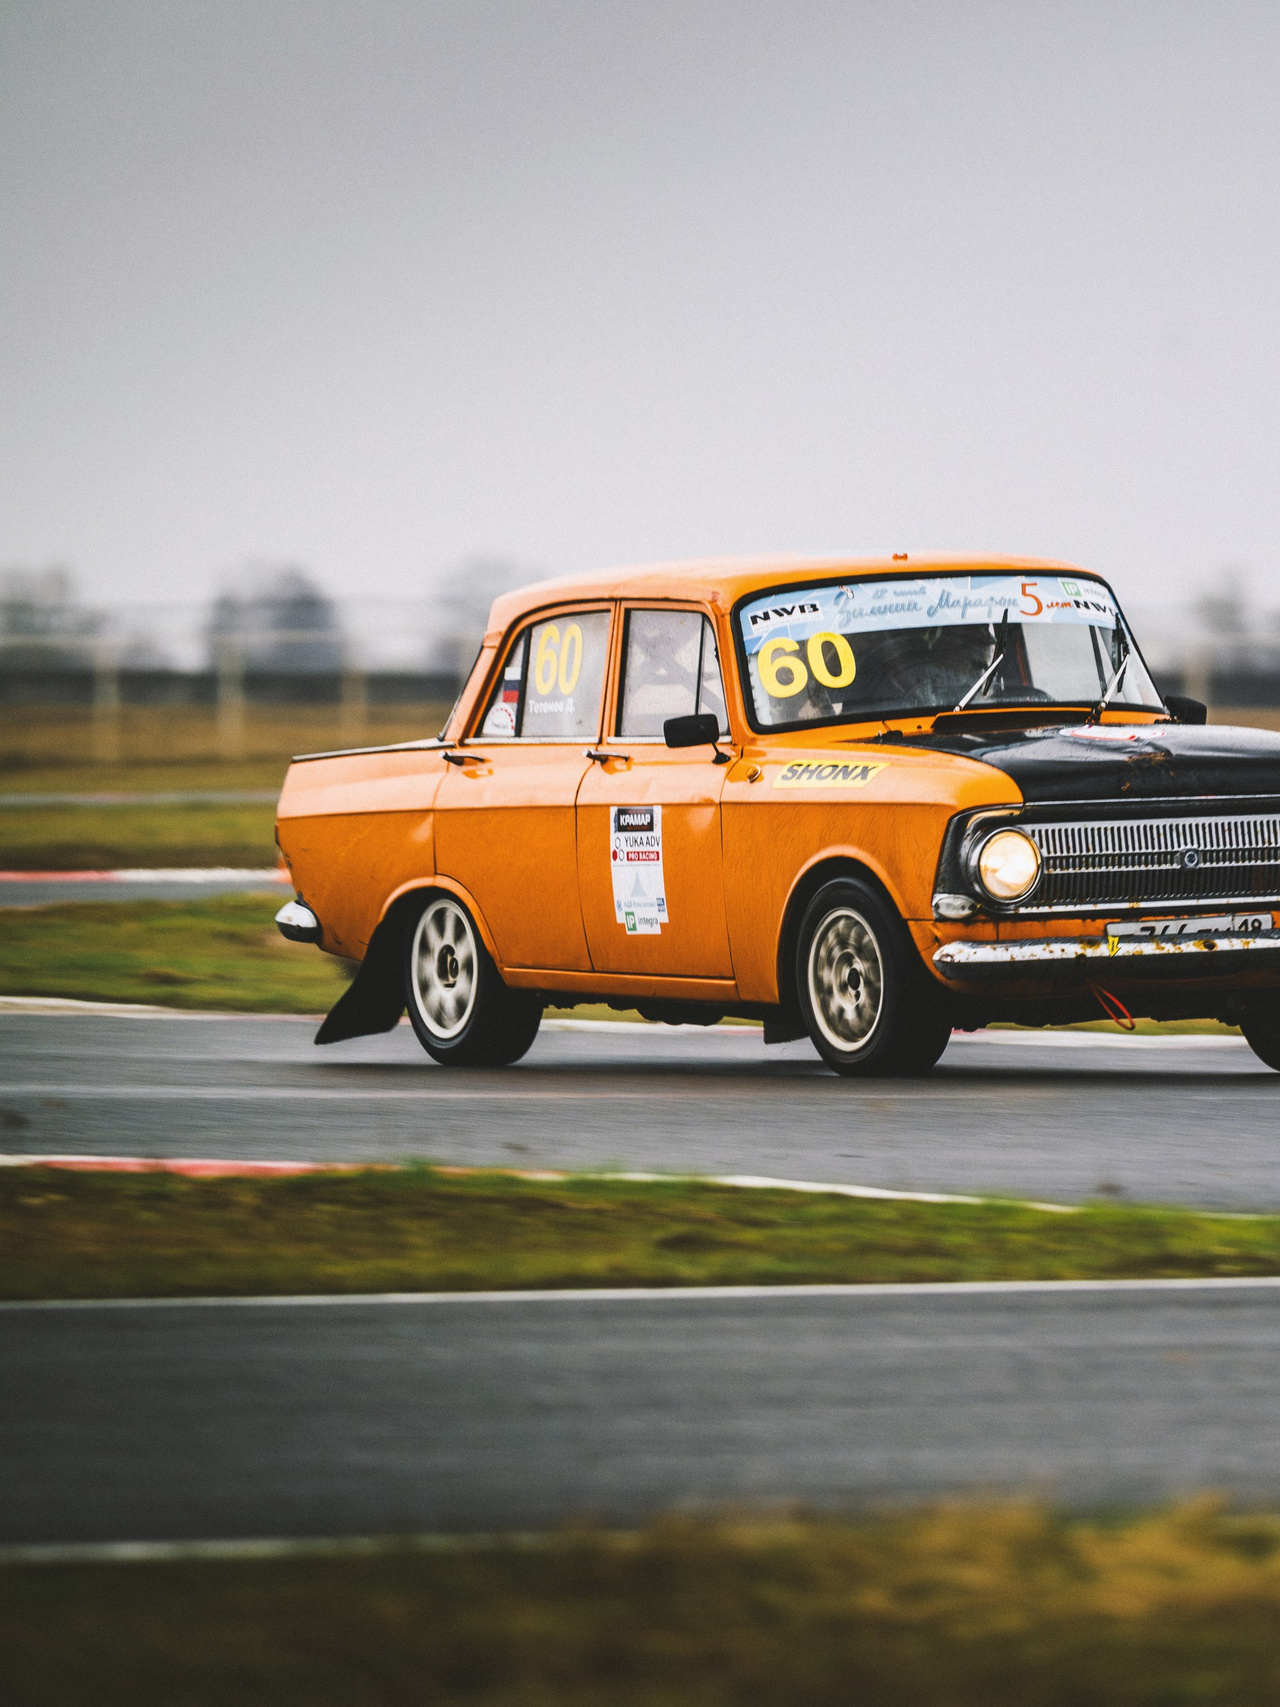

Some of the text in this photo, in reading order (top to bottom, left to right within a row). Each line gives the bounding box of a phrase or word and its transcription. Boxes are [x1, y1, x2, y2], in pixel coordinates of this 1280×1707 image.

[1020, 582, 1043, 616] 5
[750, 603, 820, 625] NWB
[535, 623, 583, 696] 60
[757, 631, 856, 699] 60
[781, 763, 878, 781] SHONX
[624, 835, 661, 847] YUKA ADV
